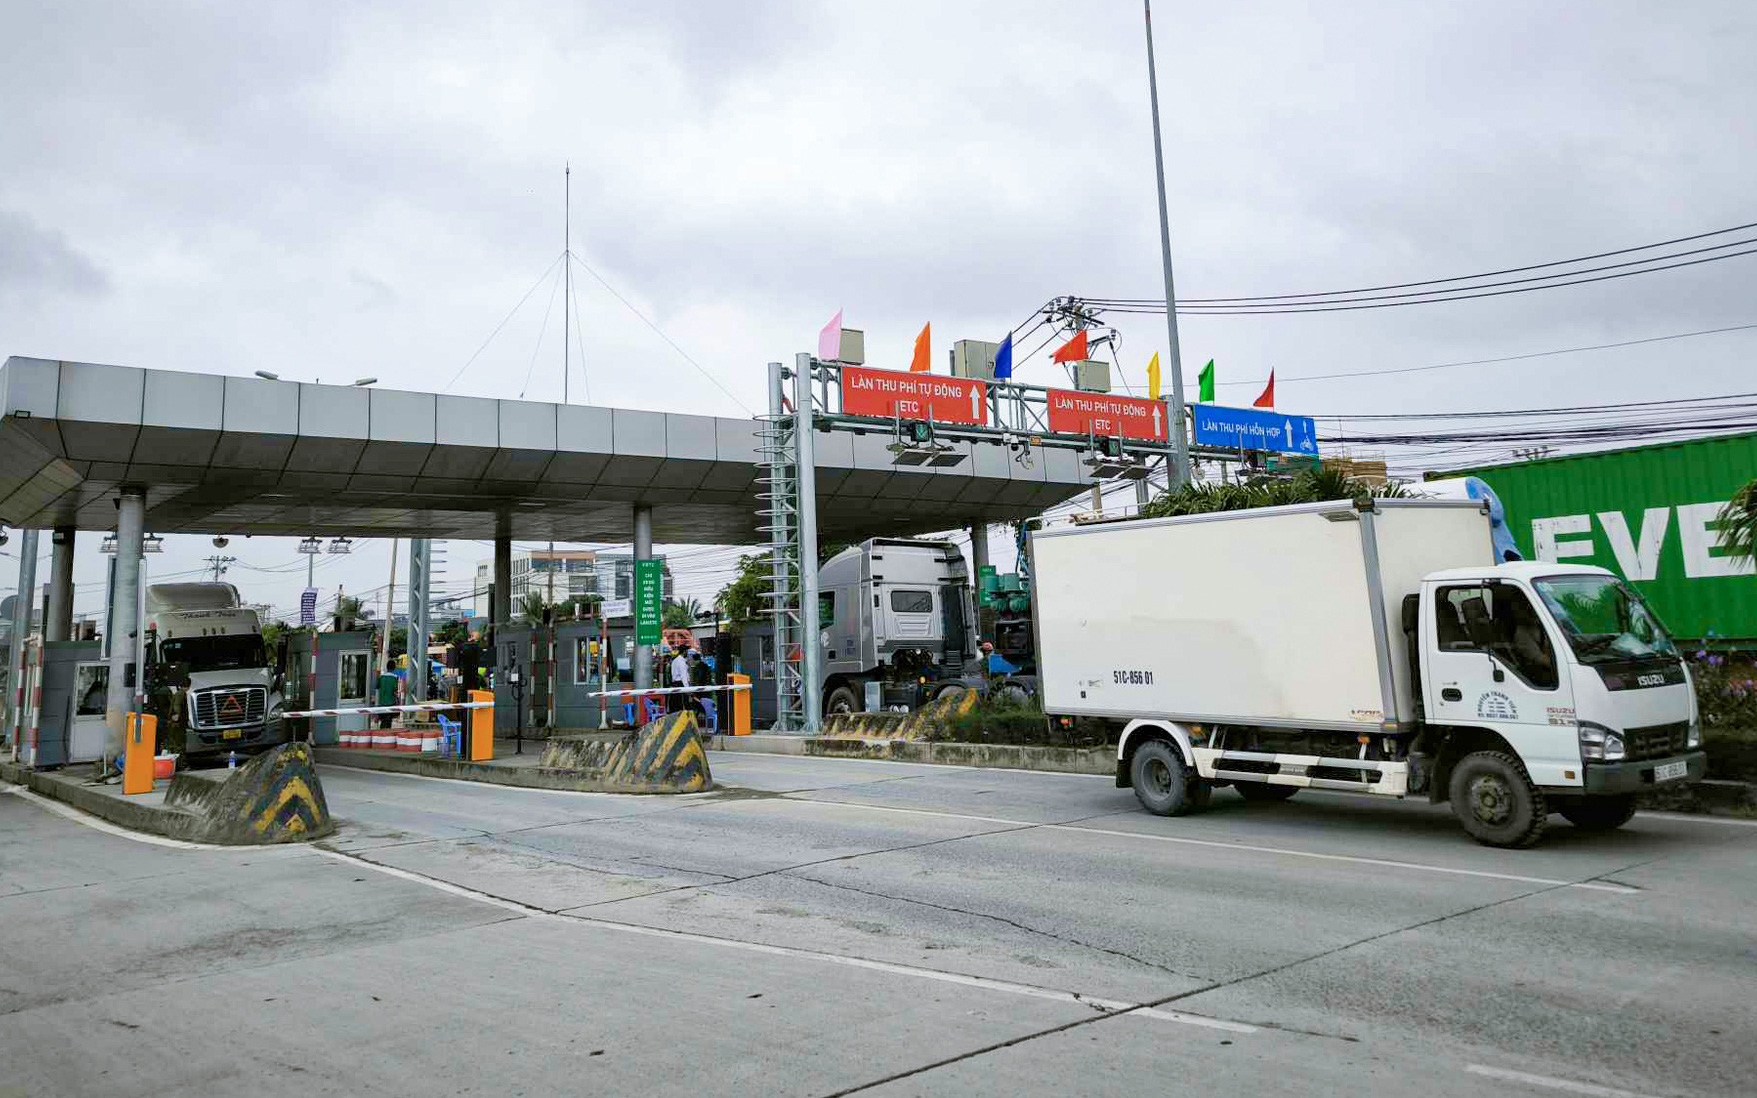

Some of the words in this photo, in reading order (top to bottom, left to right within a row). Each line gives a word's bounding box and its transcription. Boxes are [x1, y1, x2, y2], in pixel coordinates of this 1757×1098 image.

[851, 374, 873, 389] LÀN
[876, 378, 896, 391] THU
[900, 380, 917, 394] PHÍ
[919, 383, 933, 397] TỰ
[934, 383, 962, 398] ĐỘNG
[900, 400, 918, 412] ETC
[1055, 396, 1073, 409] LÀN
[1076, 399, 1092, 411] THU
[1094, 400, 1109, 413] PHÍ
[1110, 403, 1121, 416] TỰ
[1095, 419, 1111, 431] ETC
[1202, 417, 1217, 431] LÀN
[1219, 422, 1234, 432] THU
[1236, 422, 1248, 434] PHÍ
[1144, 671, 1154, 685] 01
[1637, 673, 1665, 686] ISUZU
